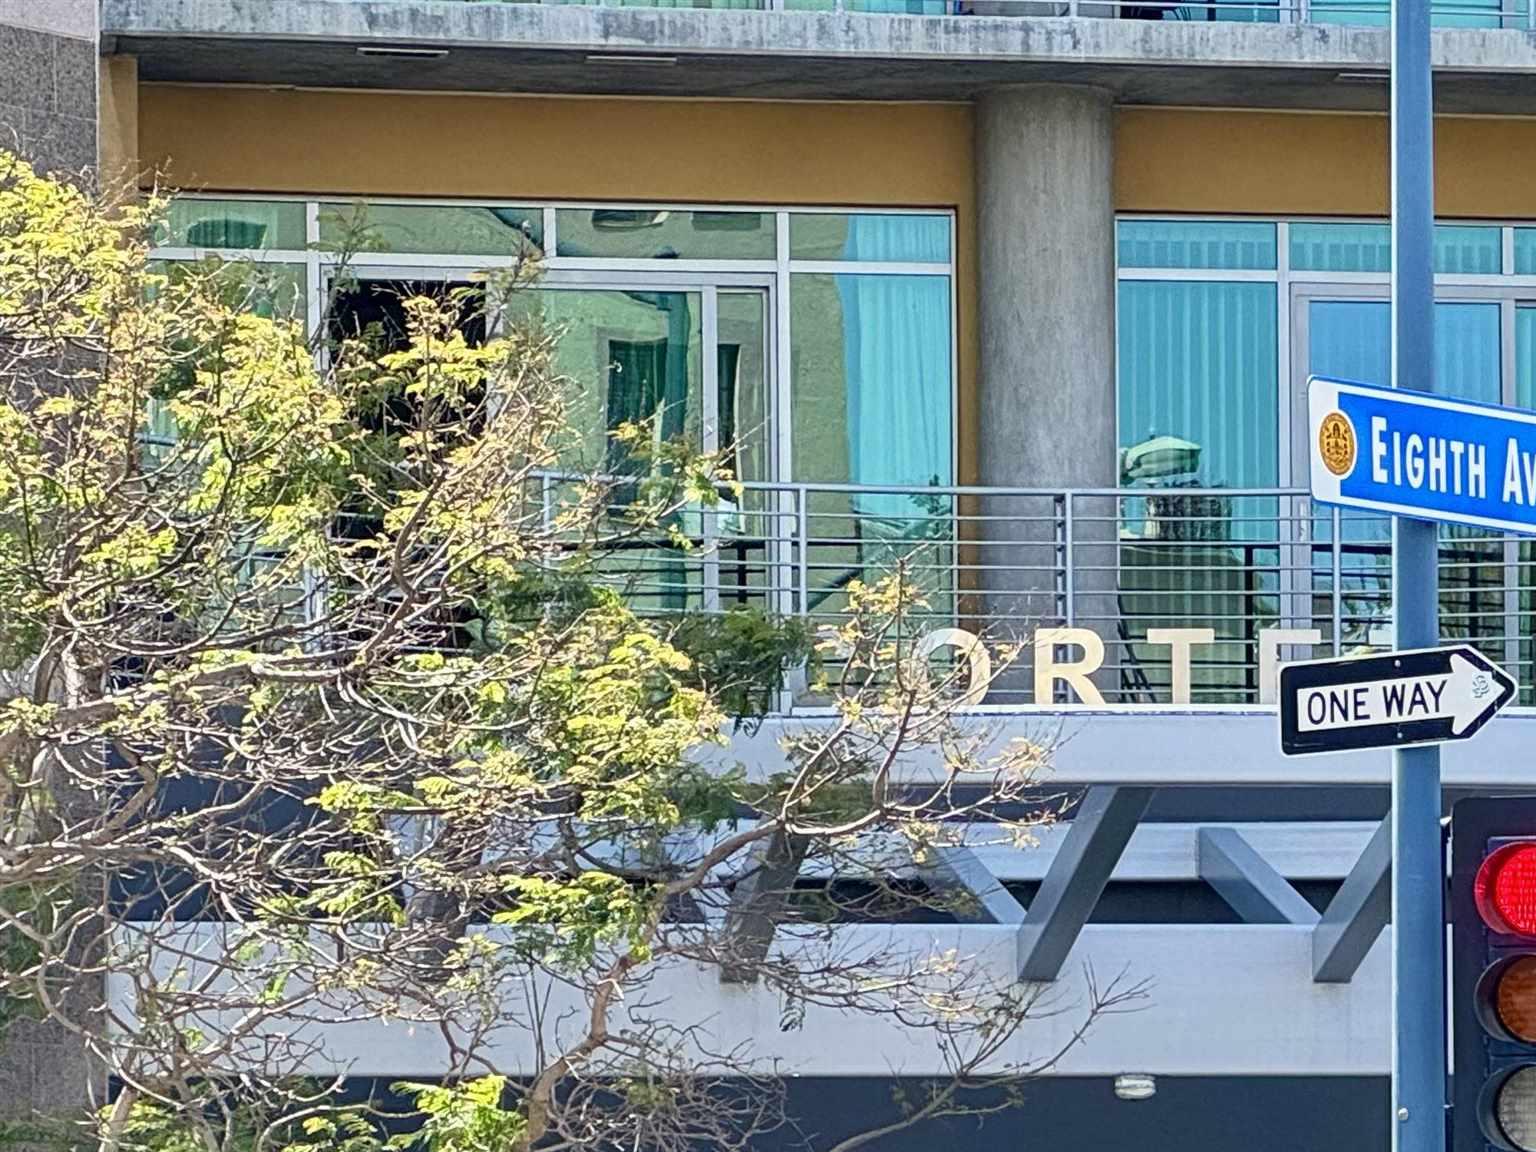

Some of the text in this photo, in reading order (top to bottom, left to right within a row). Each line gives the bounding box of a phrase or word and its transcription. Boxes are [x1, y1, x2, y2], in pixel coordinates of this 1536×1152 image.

[1371, 415, 1487, 499] EIGHTH
[1307, 687, 1371, 726] ONE
[1382, 679, 1448, 718] WAY
